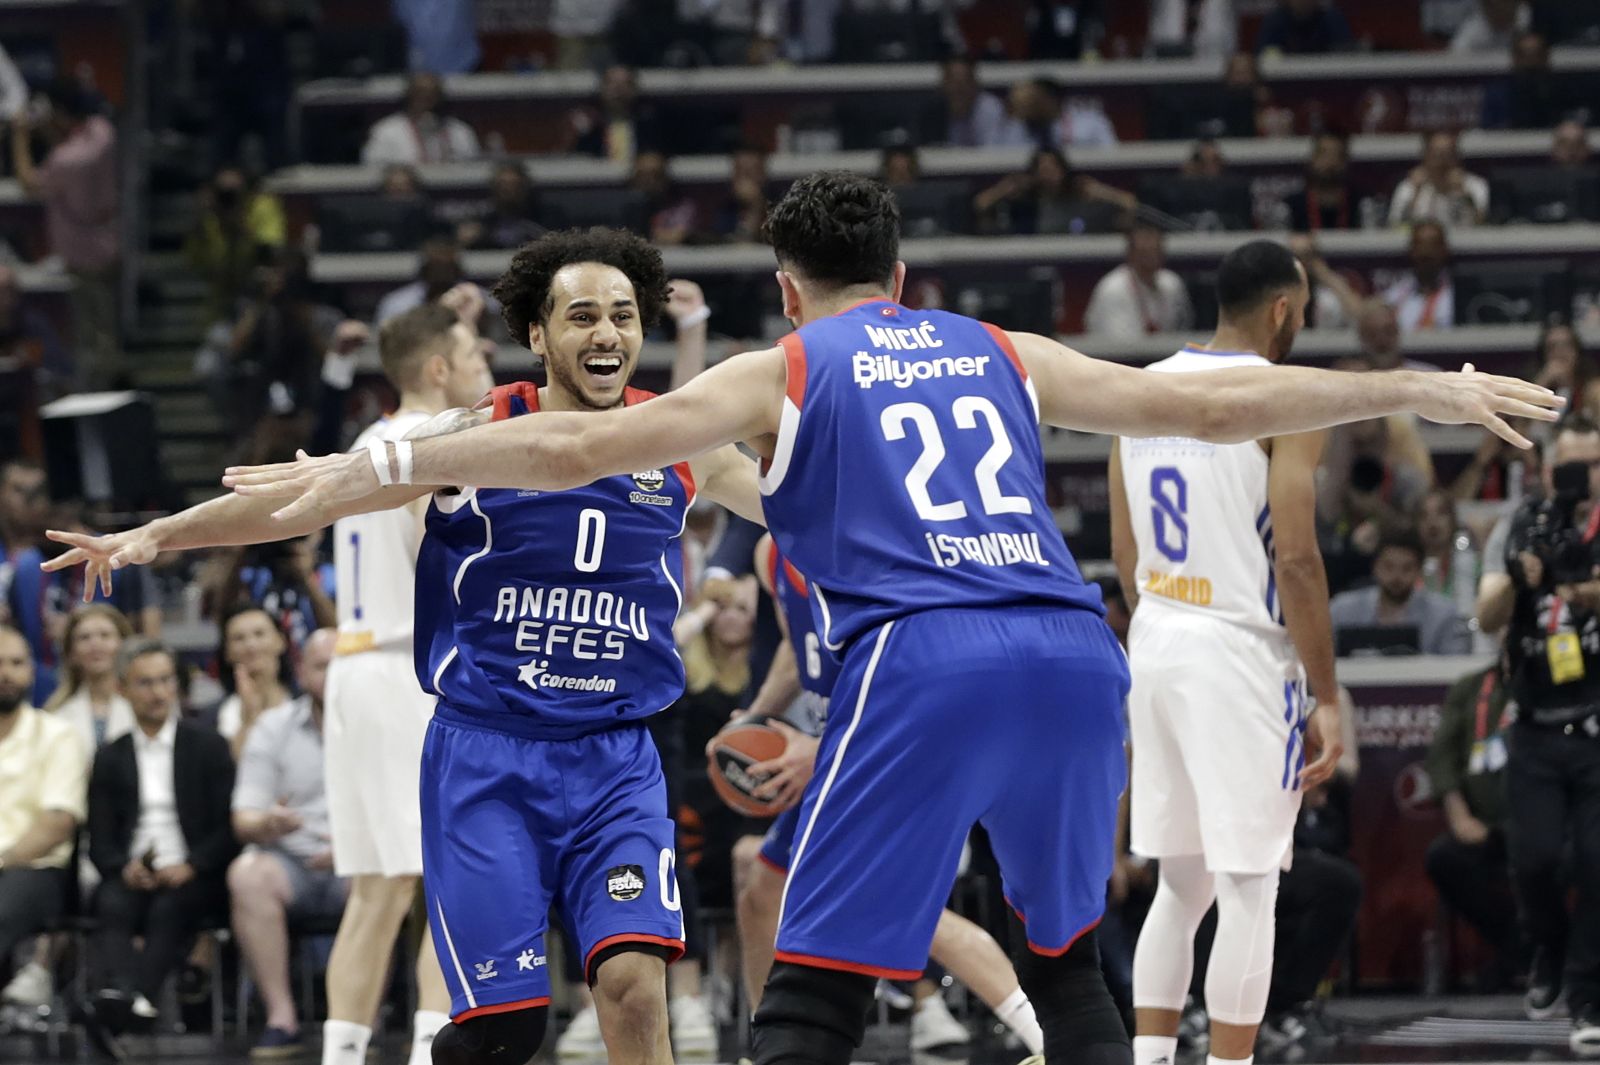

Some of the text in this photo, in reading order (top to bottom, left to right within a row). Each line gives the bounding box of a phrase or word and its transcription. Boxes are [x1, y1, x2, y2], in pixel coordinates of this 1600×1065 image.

[864, 320, 944, 350] MICIĆ
[852, 351, 990, 388] Bilyoner
[880, 396, 1032, 521] 22
[574, 508, 606, 572] 0
[350, 532, 362, 620] 1
[493, 587, 650, 641] ANADOLU
[515, 620, 629, 660] EFES
[804, 631, 821, 679] 6
[539, 672, 616, 693] corendon
